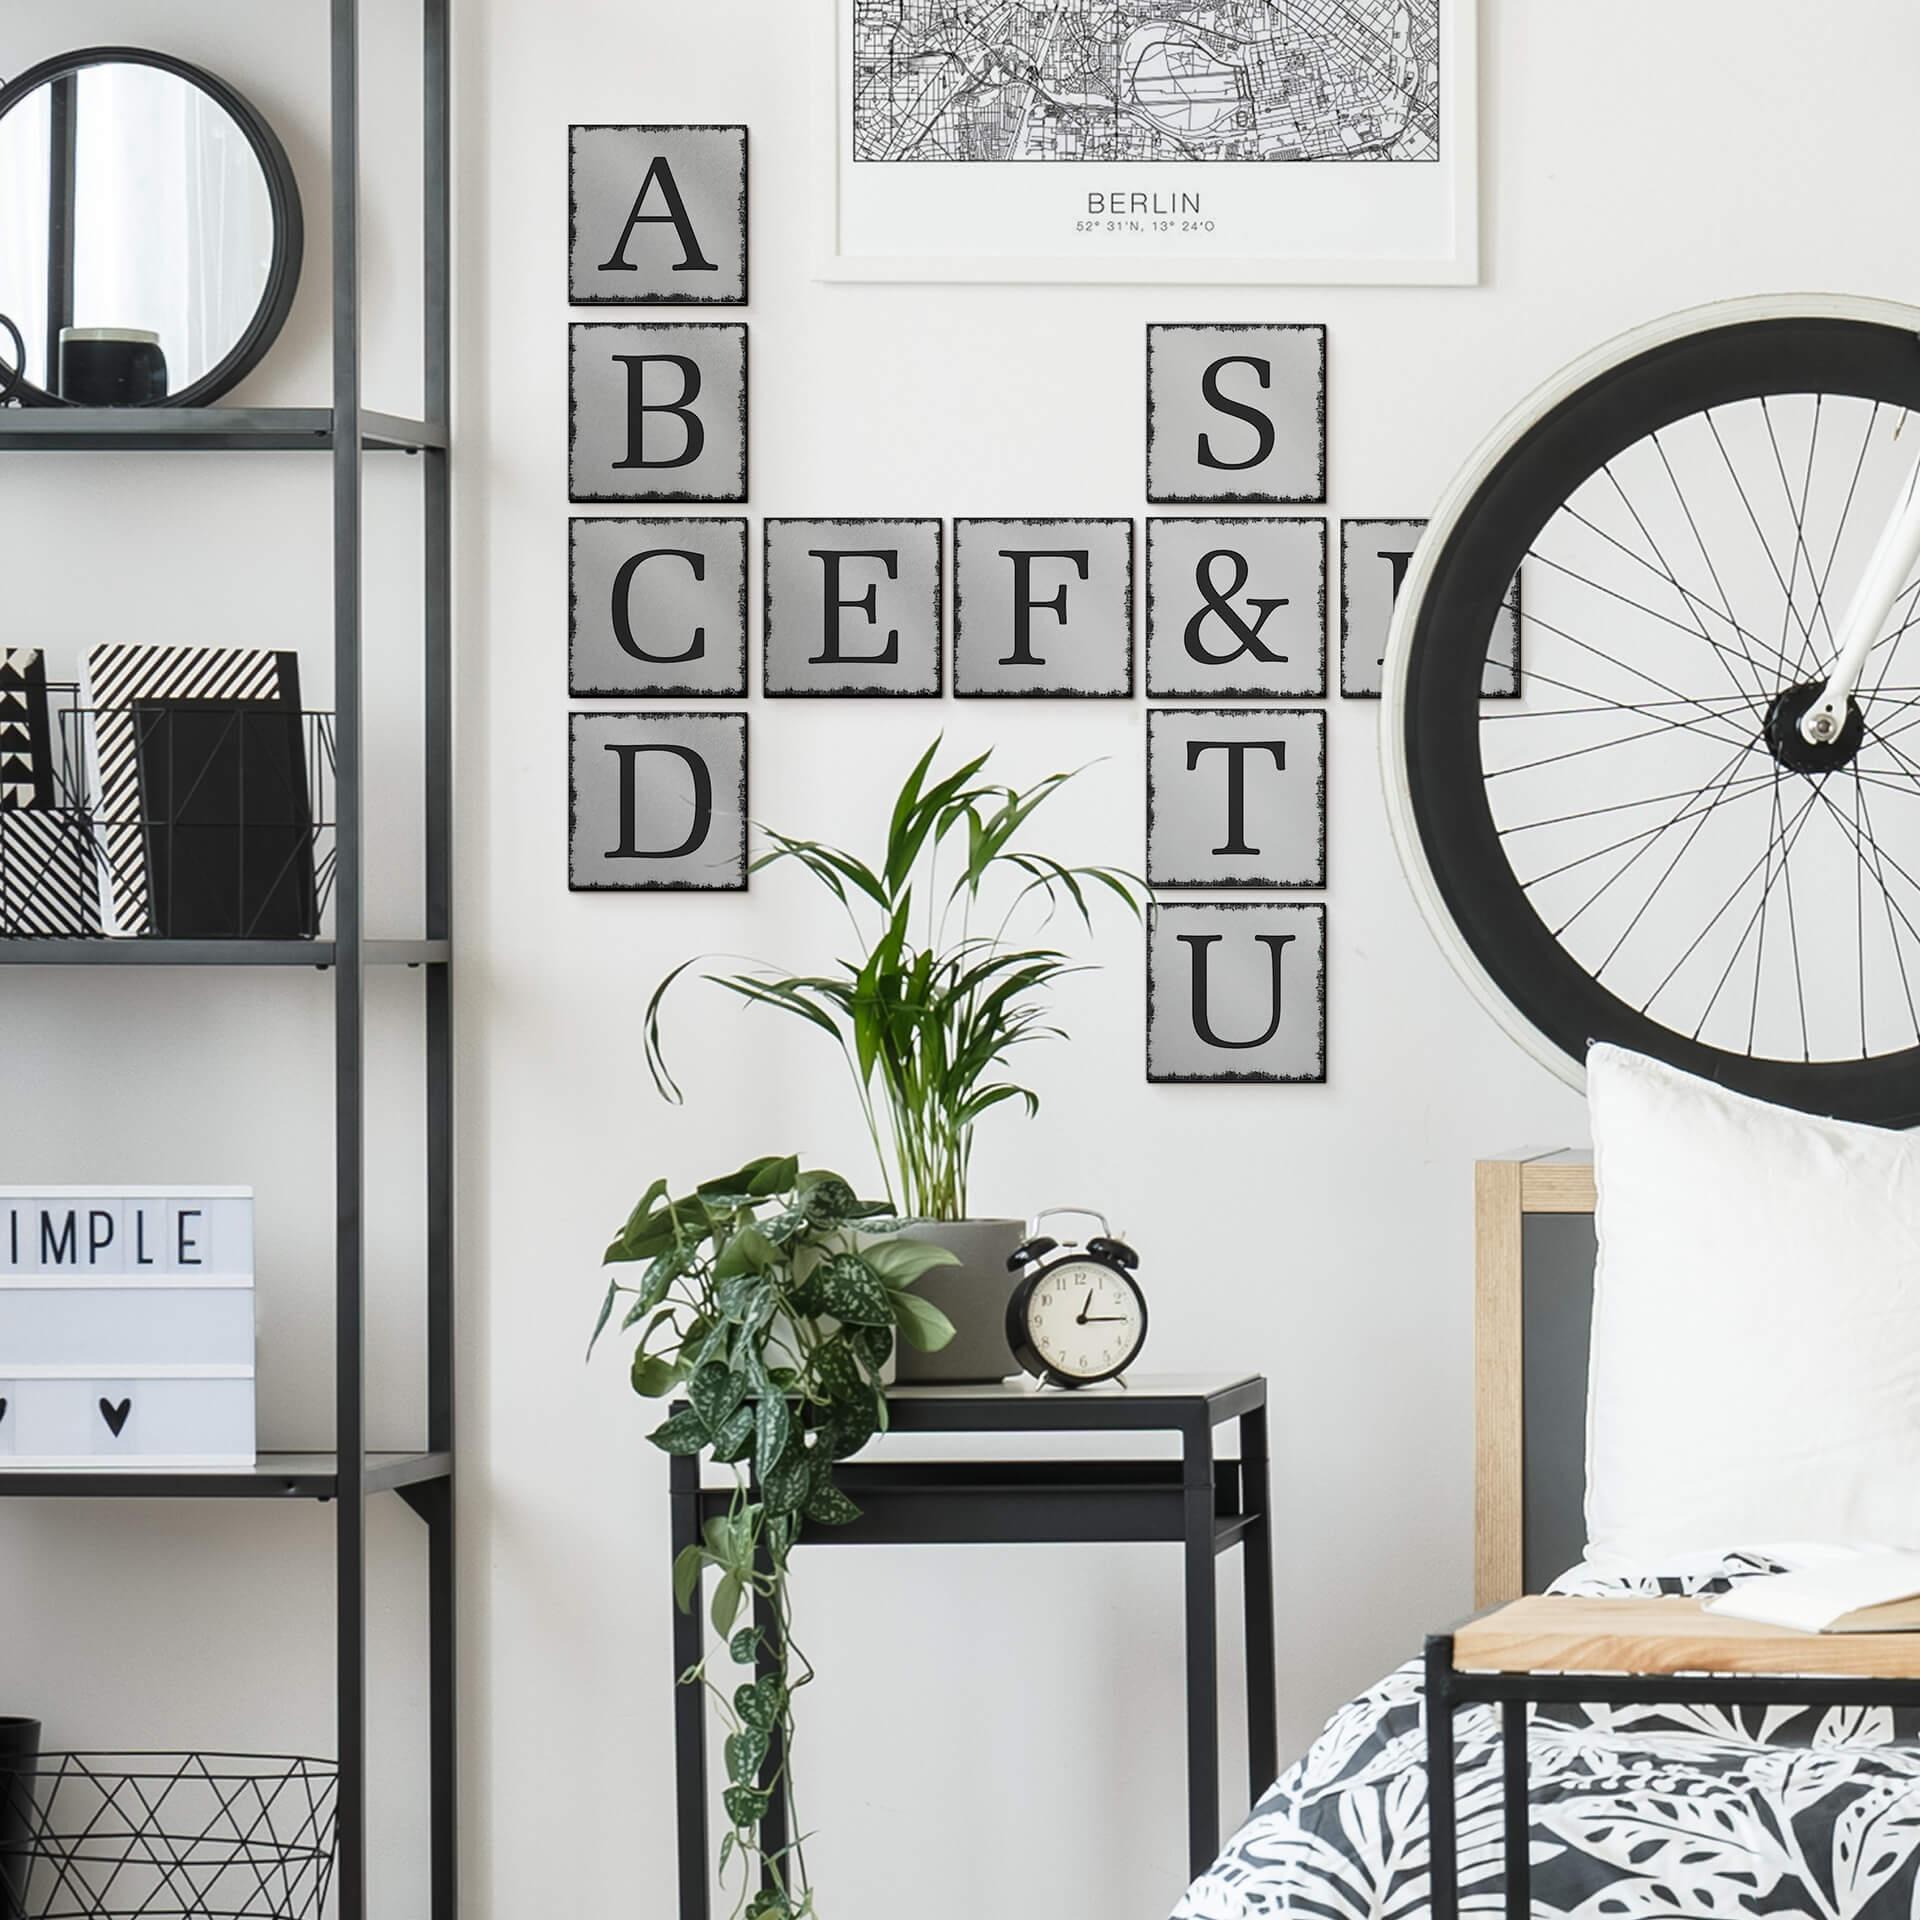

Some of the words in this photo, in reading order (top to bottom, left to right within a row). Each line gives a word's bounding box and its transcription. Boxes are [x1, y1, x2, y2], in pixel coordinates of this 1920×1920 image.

[598, 157, 718, 271] A
[1088, 192, 1200, 214] BERLIN
[612, 355, 705, 469] B
[1198, 356, 1275, 470] S
[611, 549, 705, 664] C
[808, 550, 899, 664] E
[998, 550, 1089, 665] F
[1184, 549, 1290, 664] &
[604, 744, 712, 858] D
[1186, 741, 1286, 855] T
[1177, 934, 1296, 1049] U
[10, 1210, 202, 1265] IMPLE
[1056, 1278, 1066, 1291] 11
[1074, 1272, 1087, 1285] 12
[1034, 1314, 1043, 1328] 9
[1041, 1294, 1053, 1307] 10
[1041, 1335, 1051, 1348] 8
[1060, 1350, 1067, 1363] 7
[1079, 1355, 1088, 1368] 6
